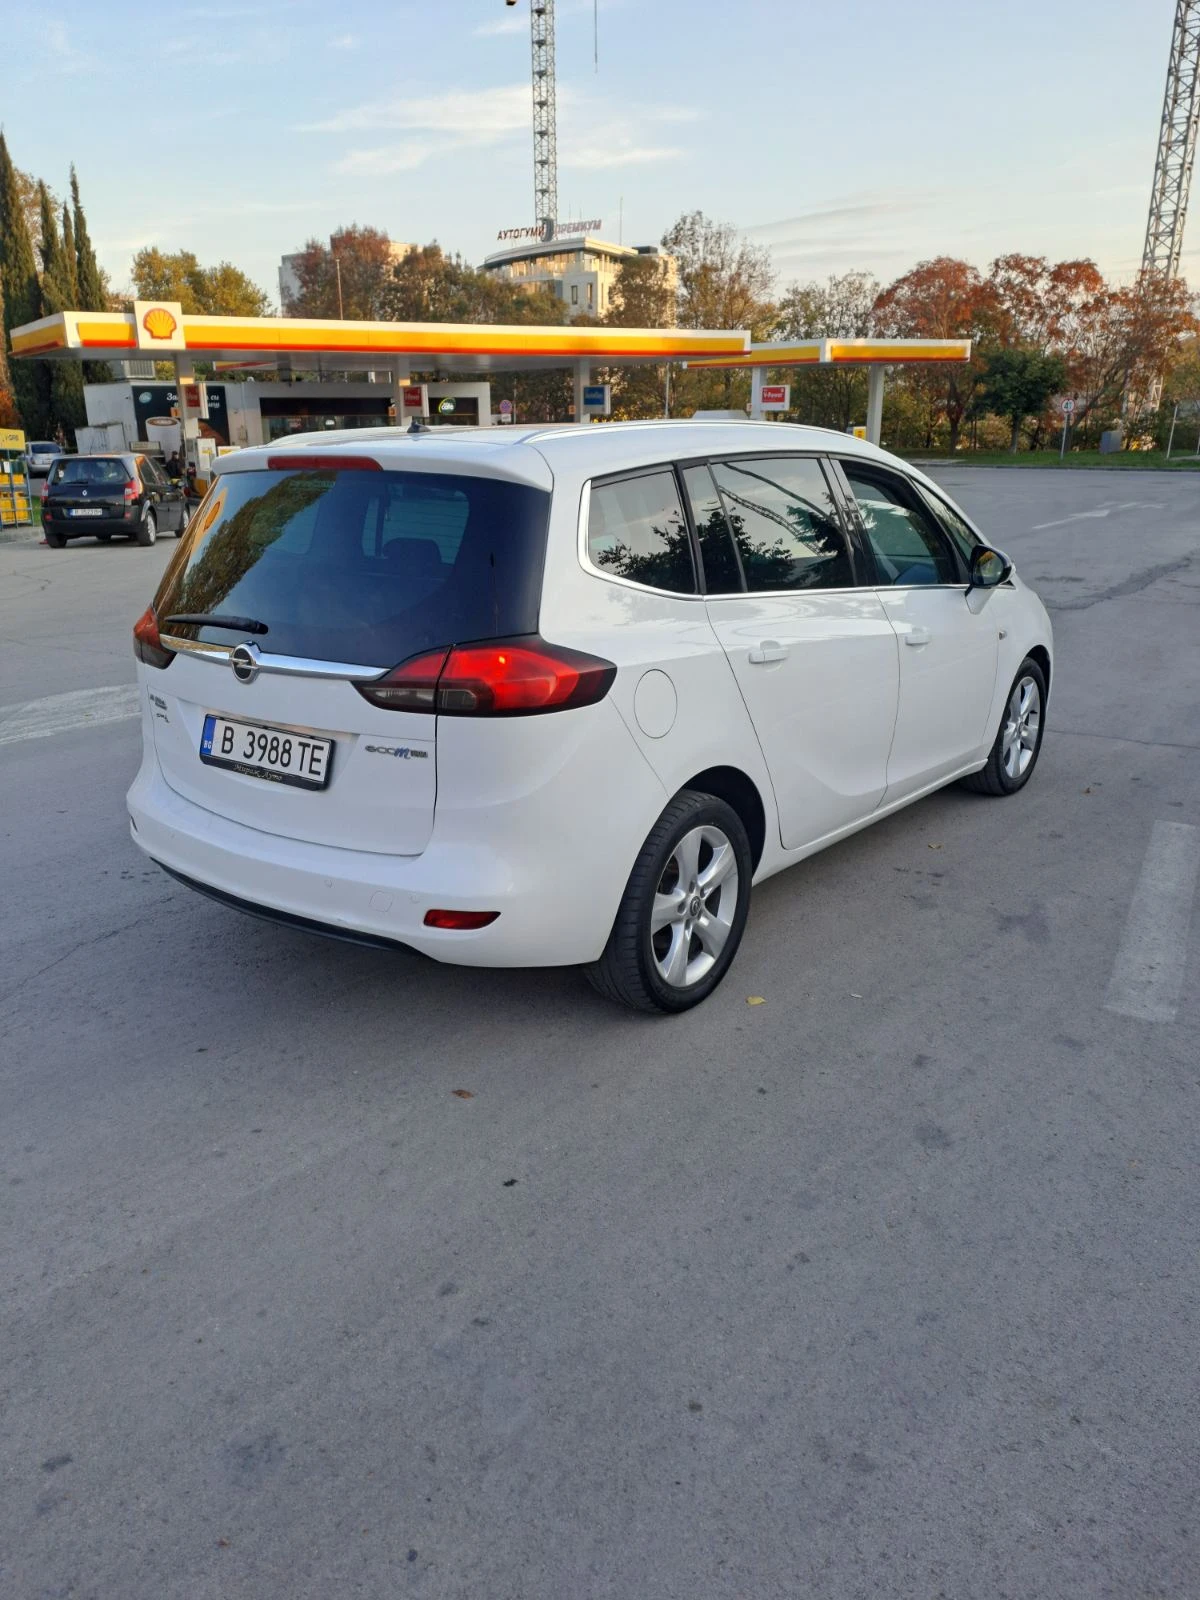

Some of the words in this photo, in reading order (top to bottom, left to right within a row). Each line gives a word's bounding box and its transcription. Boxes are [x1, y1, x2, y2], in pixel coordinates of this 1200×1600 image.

[203, 740, 213, 750] BG
[221, 726, 234, 754] B
[243, 731, 292, 767] 3988
[298, 741, 324, 775] TE
